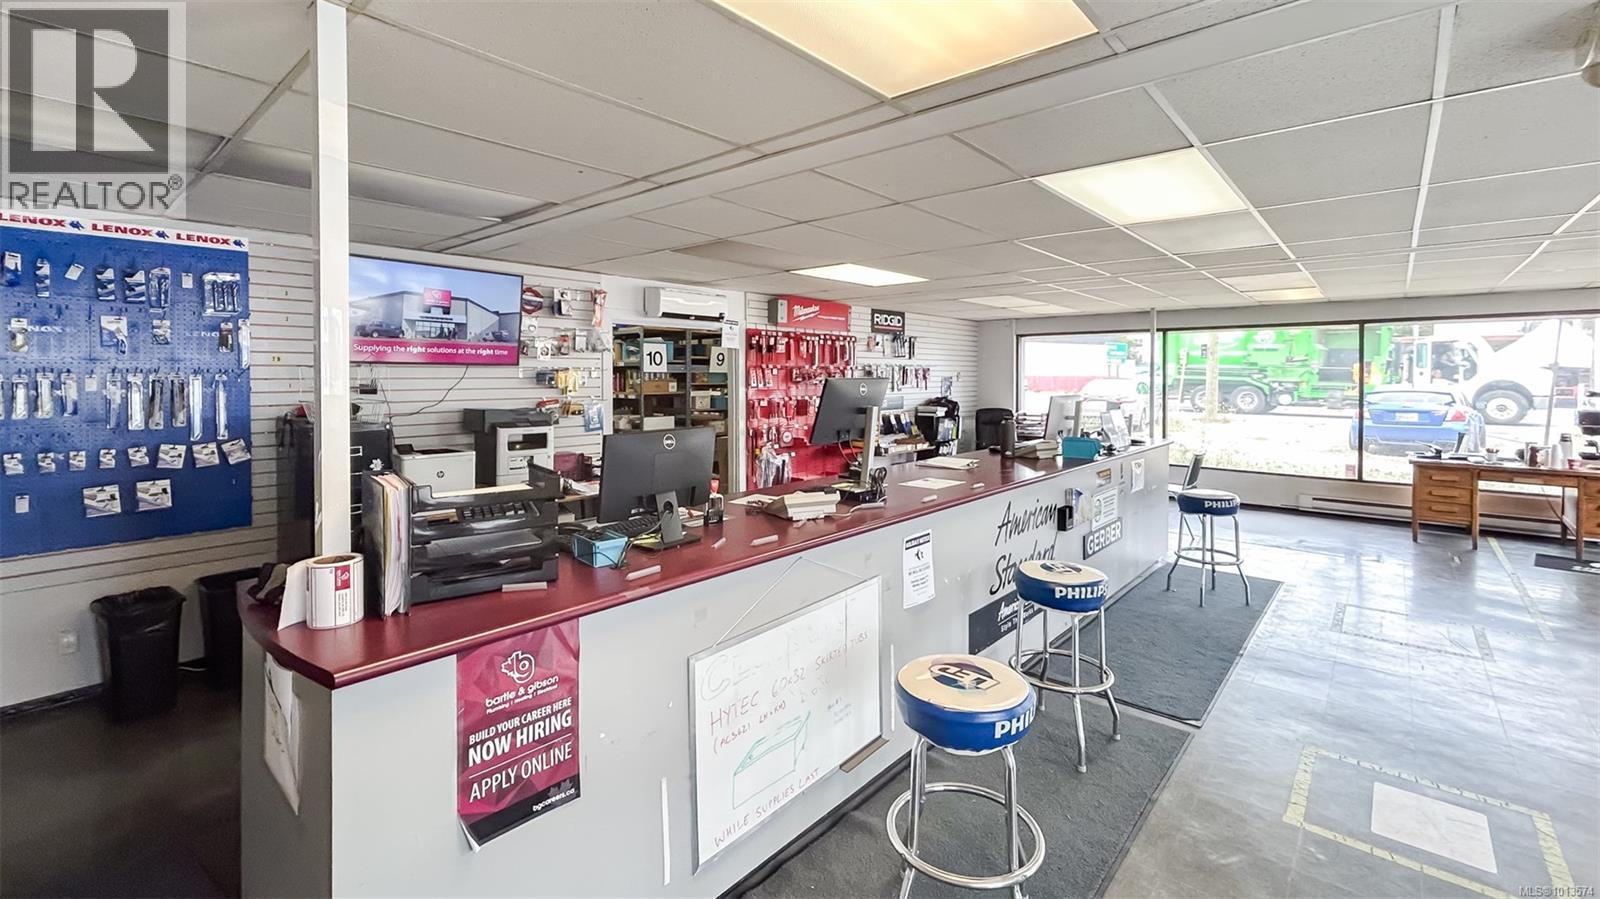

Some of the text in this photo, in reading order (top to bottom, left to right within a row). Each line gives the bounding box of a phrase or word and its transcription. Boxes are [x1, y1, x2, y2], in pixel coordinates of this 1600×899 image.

[0, 213, 66, 228] LENOX
[92, 223, 153, 237] LENOX
[176, 232, 231, 245] LENOX
[874, 313, 903, 326] RIDGID
[353, 343, 391, 353] Supplying
[406, 346, 426, 354] right
[477, 348, 494, 356] right
[646, 350, 663, 367] 10
[716, 352, 725, 367] 9
[995, 499, 1058, 547] American
[1087, 521, 1121, 555] GERBER
[485, 676, 559, 708] bartle & gibson
[469, 697, 572, 745] BUILD YOUR CAREER HERE
[711, 691, 759, 737] HYTEC
[468, 709, 572, 767] NOW HIRING
[469, 742, 572, 803] APPLY ONLINE
[714, 768, 820, 848] WHILE SUPPLIES LAST
